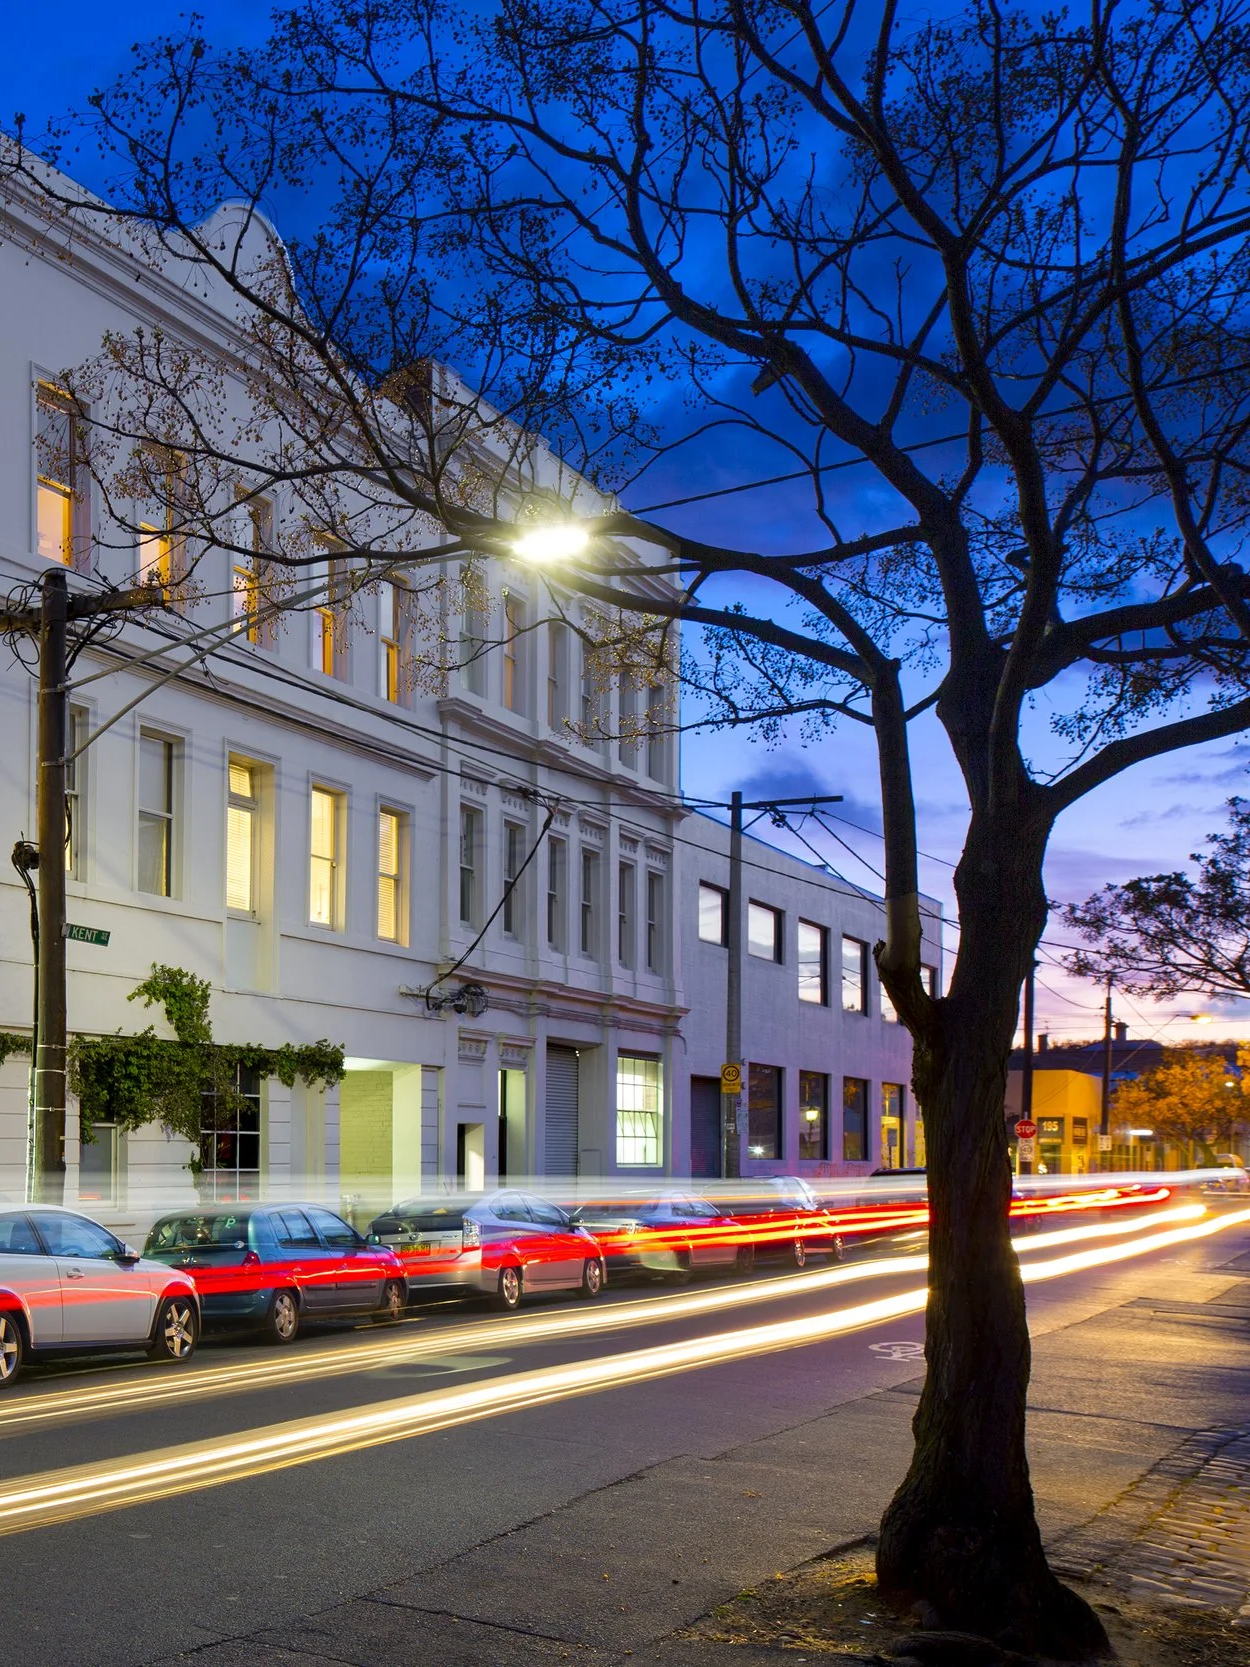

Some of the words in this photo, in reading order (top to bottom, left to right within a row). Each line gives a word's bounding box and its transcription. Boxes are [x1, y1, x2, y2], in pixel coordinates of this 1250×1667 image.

[71, 926, 98, 941] KENT
[726, 1069, 737, 1077] 40
[1016, 1125, 1037, 1134] STOP
[1042, 1121, 1059, 1132] 195
